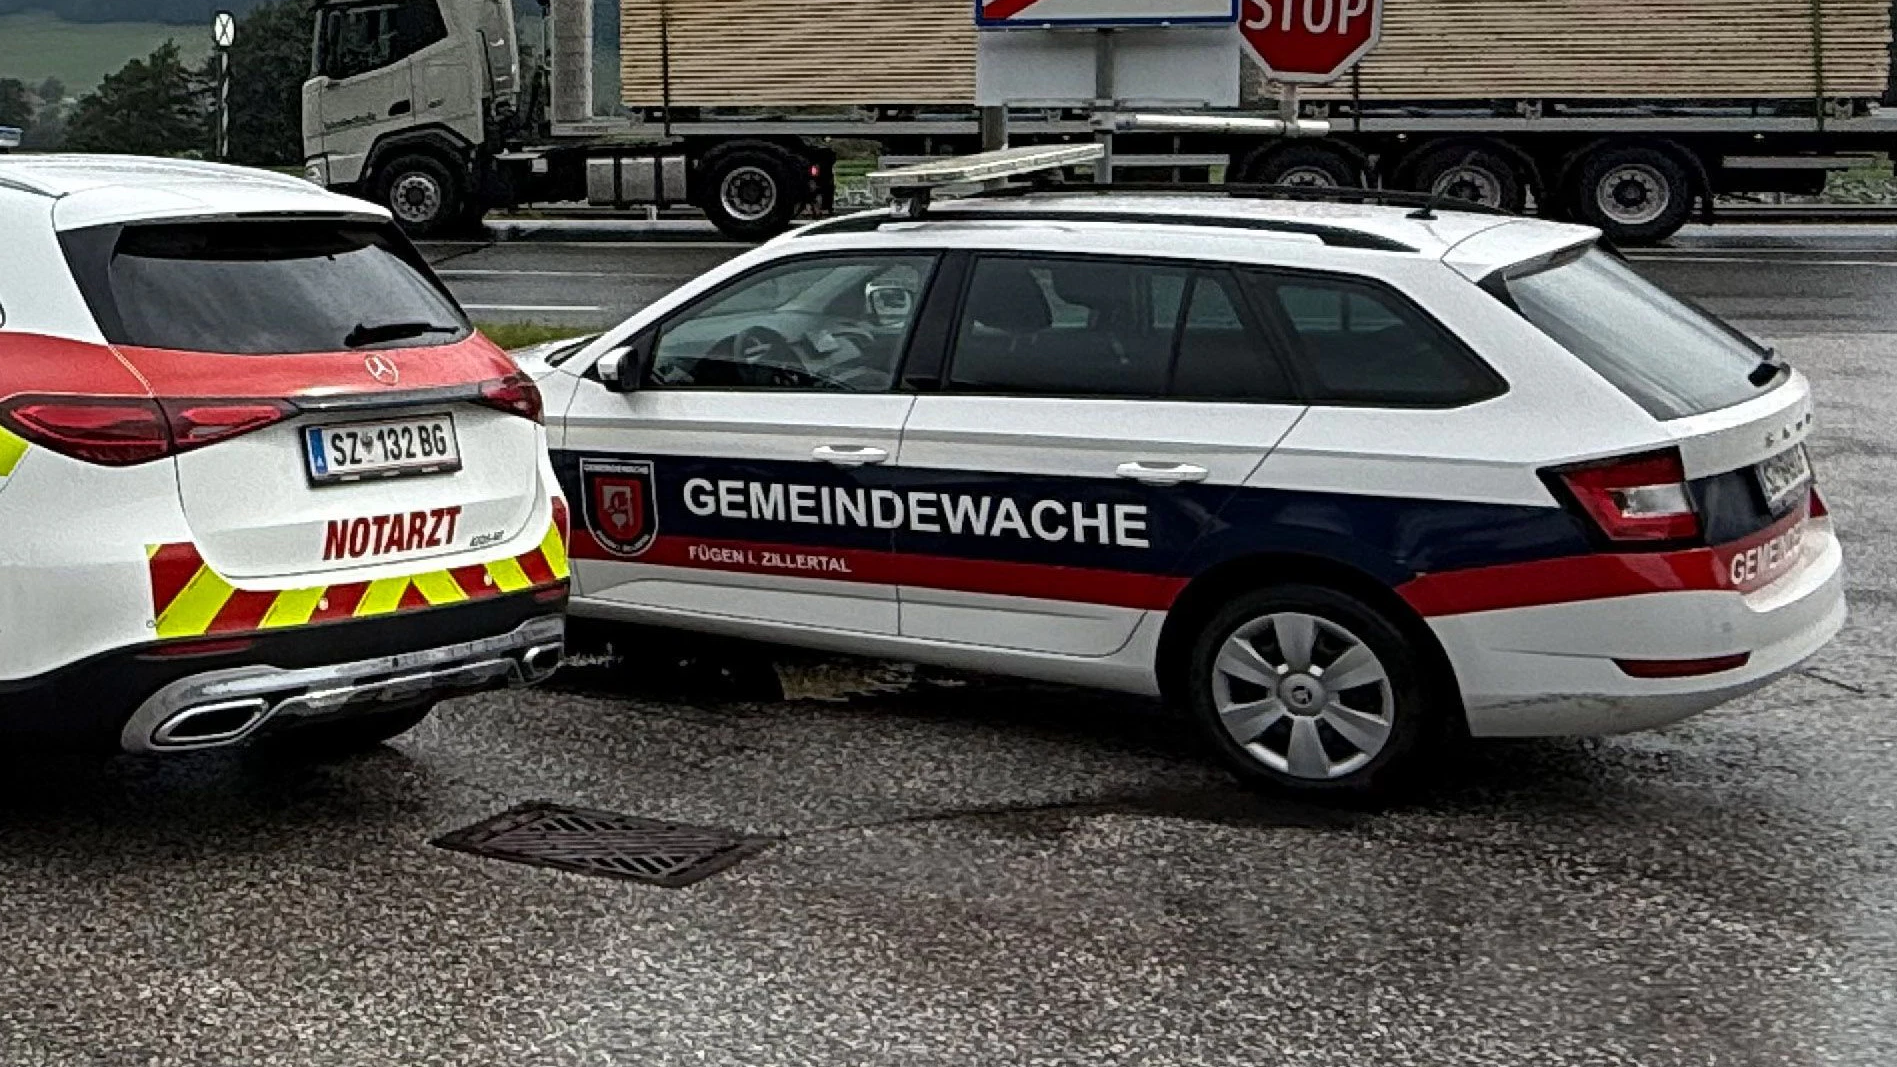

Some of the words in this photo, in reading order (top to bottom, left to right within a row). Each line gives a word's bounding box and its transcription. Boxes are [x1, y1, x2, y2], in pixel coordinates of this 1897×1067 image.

[330, 431, 363, 467] SZ
[375, 425, 417, 462] 132
[417, 423, 447, 457] BG
[322, 505, 463, 561] NOTARZT
[682, 476, 1151, 549] GEMEINDEWACHE
[687, 543, 745, 565] FÜGEN
[760, 551, 853, 574] ZILLERTAL
